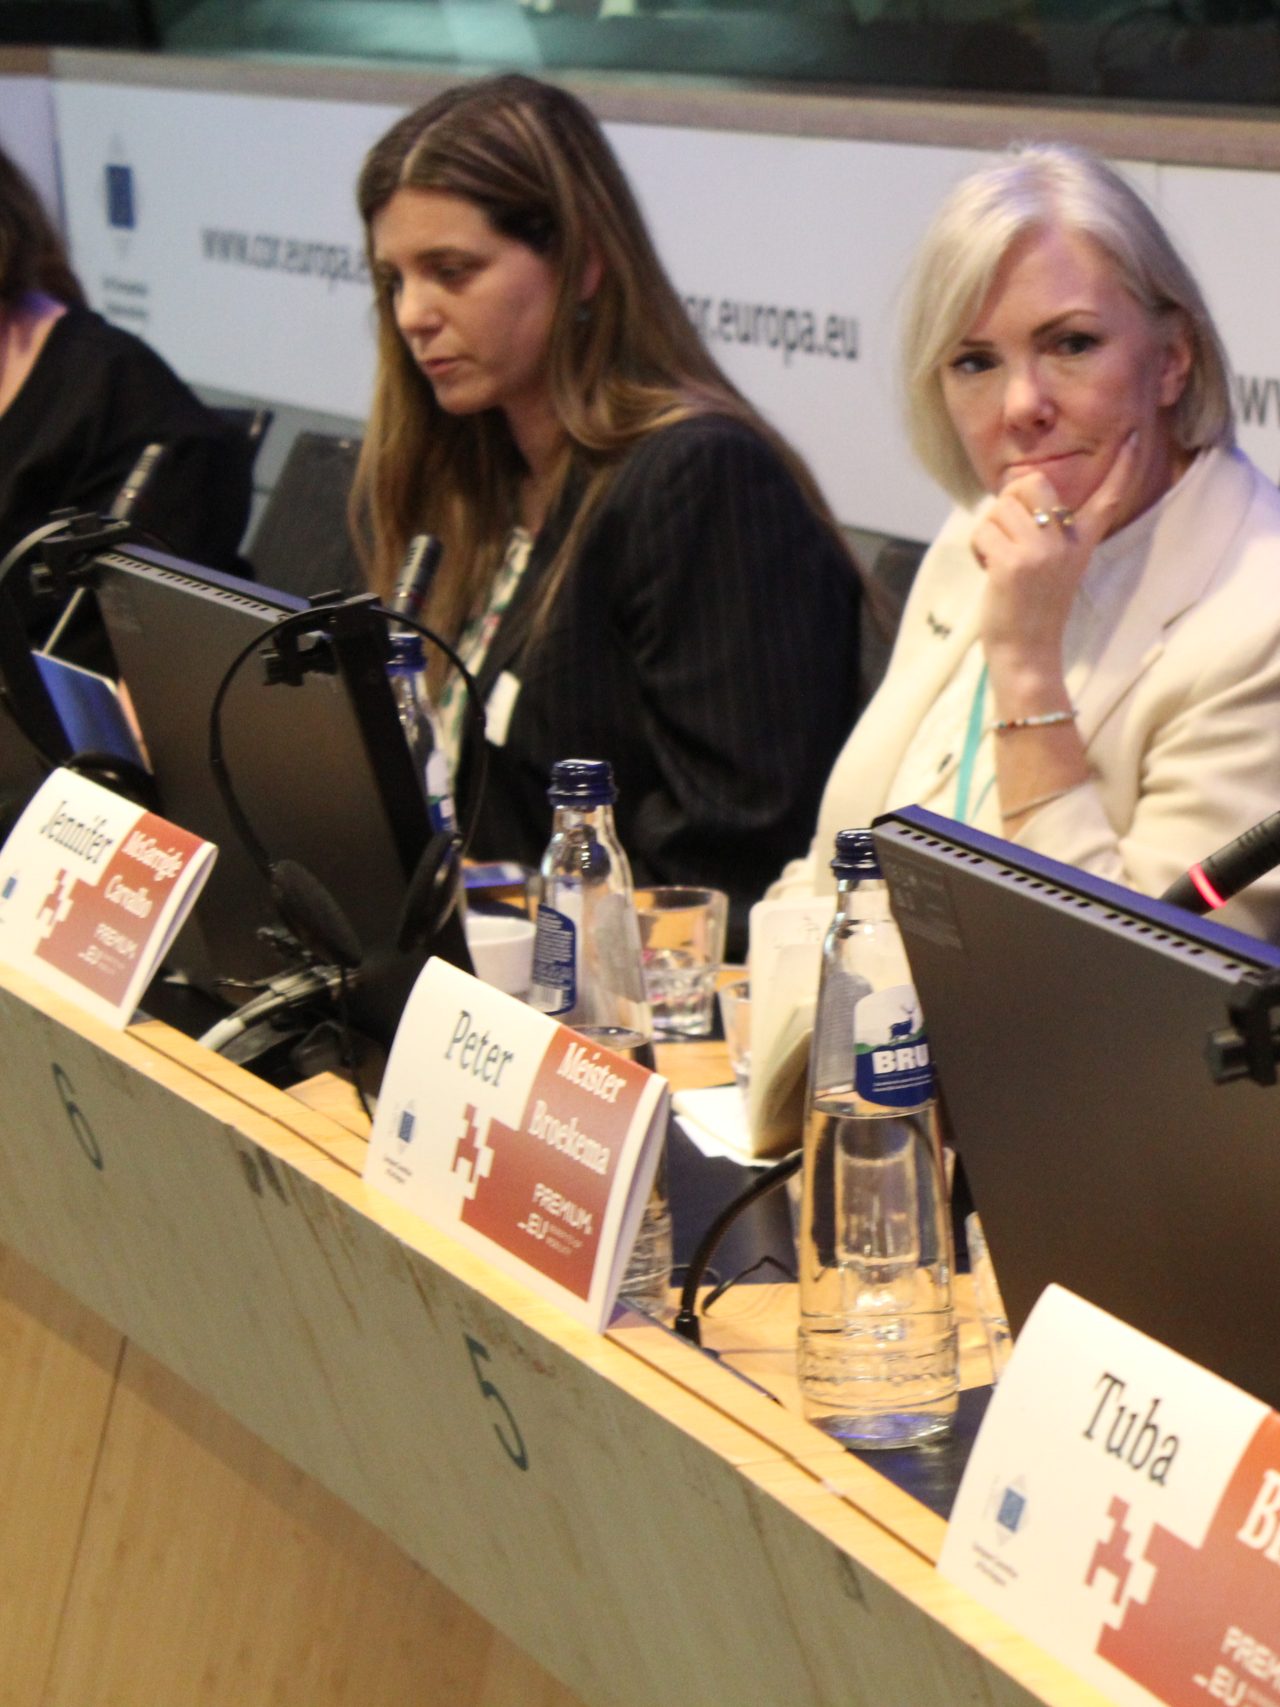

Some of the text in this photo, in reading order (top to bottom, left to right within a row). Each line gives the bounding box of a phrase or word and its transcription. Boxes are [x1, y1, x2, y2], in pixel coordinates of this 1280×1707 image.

[40, 800, 113, 864] Jennifer
[445, 1009, 515, 1088] Peter
[556, 1042, 627, 1103] Meister
[872, 1043, 929, 1074] BRU
[51, 1062, 104, 1171] 6
[527, 1099, 612, 1176] Broekema
[531, 1182, 594, 1236] PREMIUM
[463, 1332, 529, 1472] 5
[1081, 1371, 1181, 1487] Tuba
